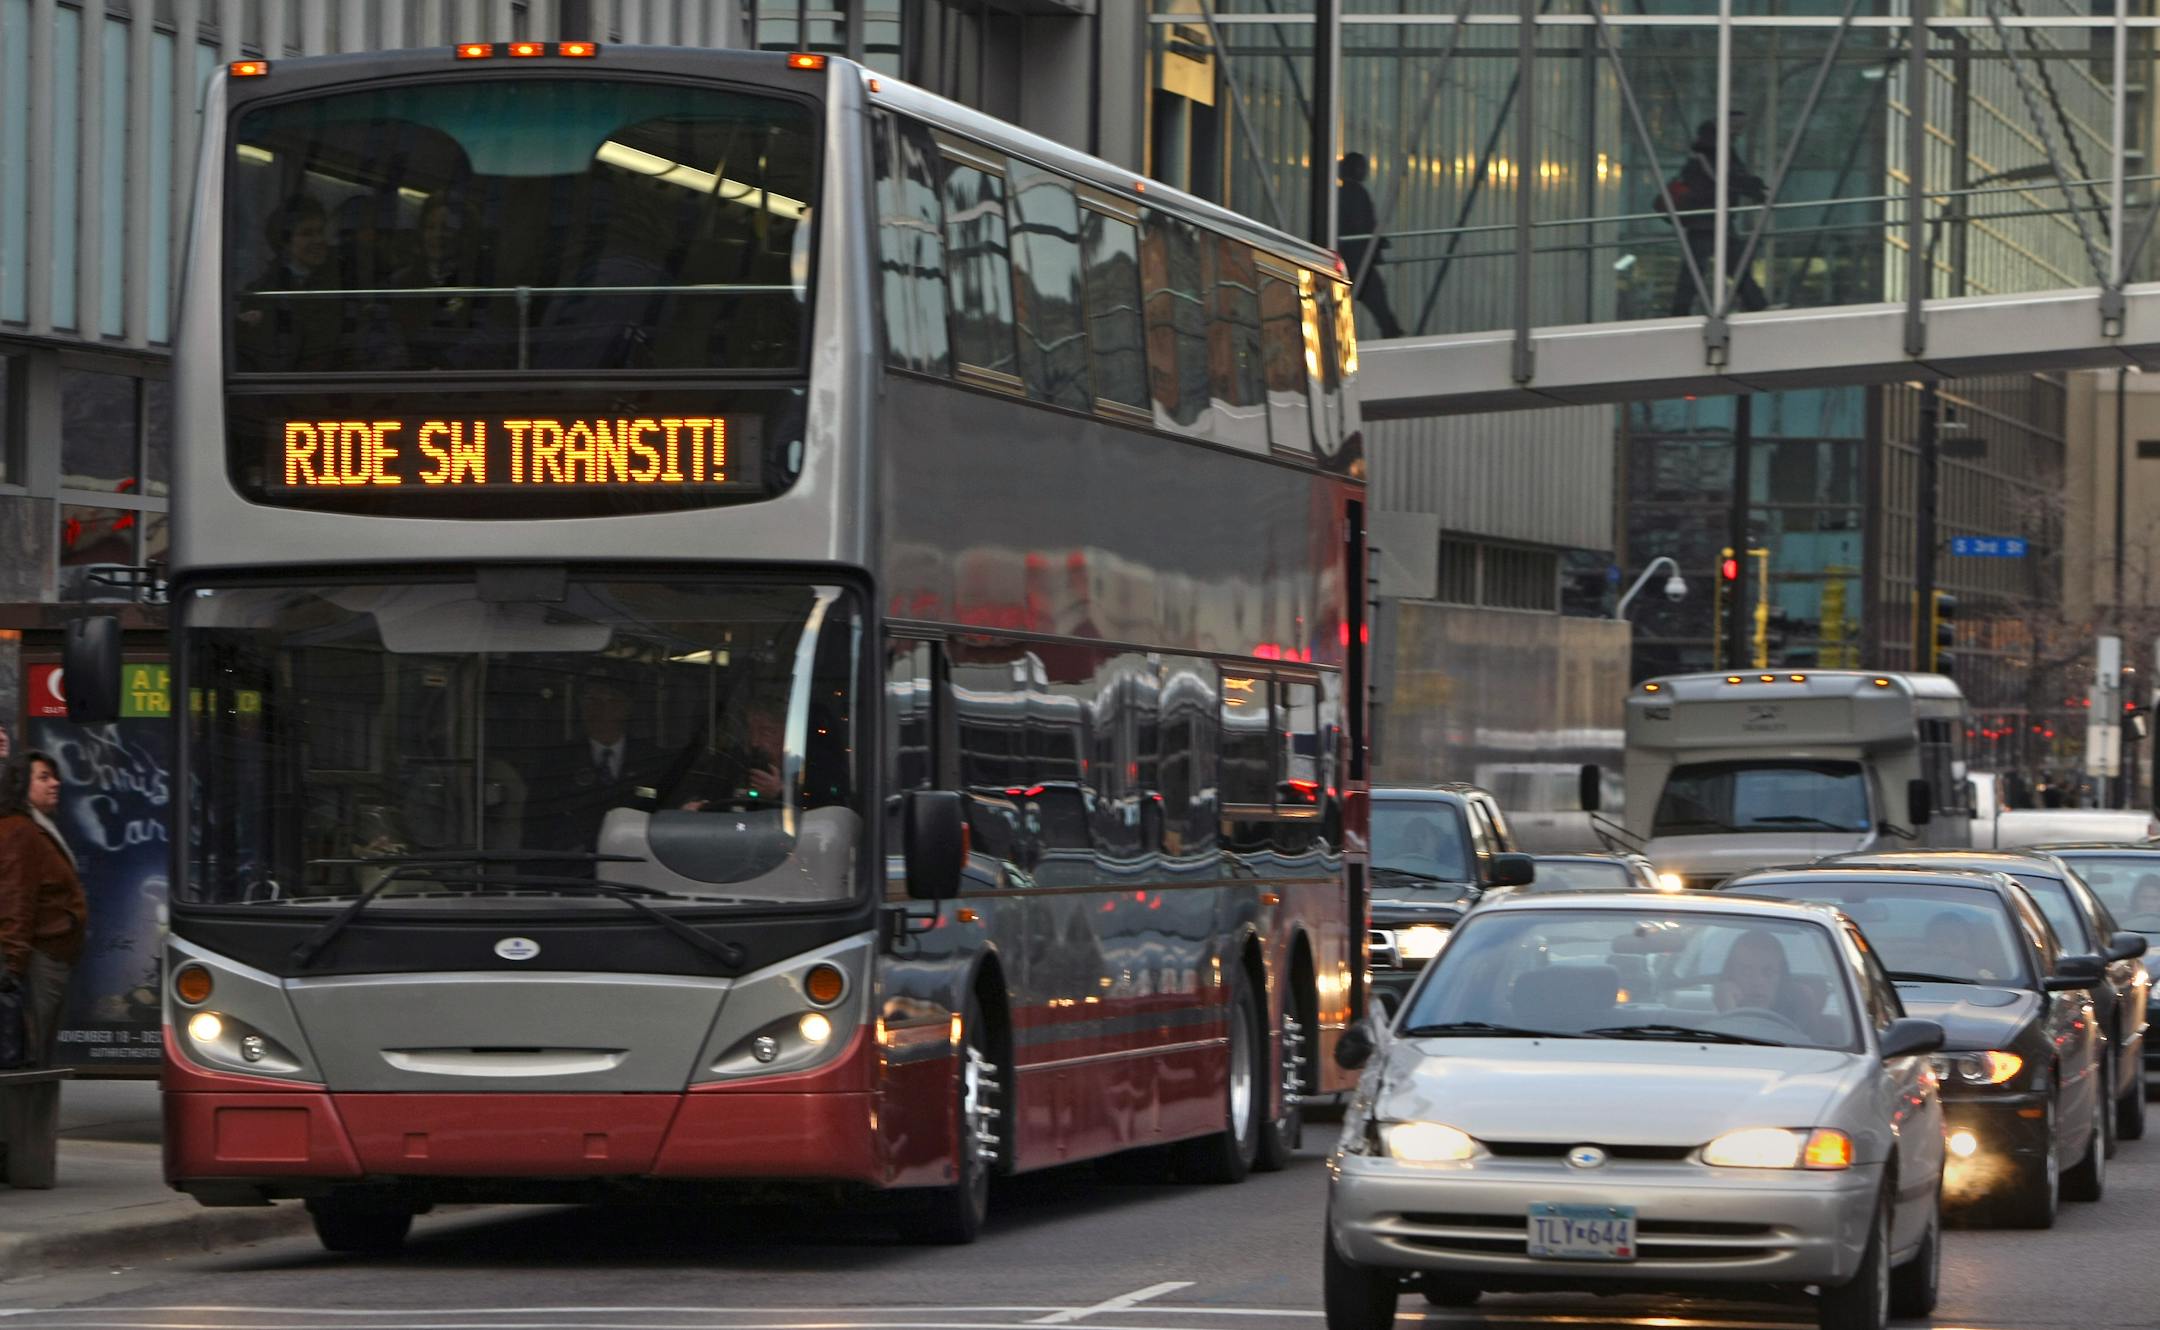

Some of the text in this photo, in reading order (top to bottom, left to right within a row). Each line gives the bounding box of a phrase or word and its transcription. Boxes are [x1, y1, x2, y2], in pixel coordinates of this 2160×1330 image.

[285, 418, 725, 486] RIDE SW TRANSIT!
[1956, 539, 1967, 554] S
[131, 669, 151, 690] A
